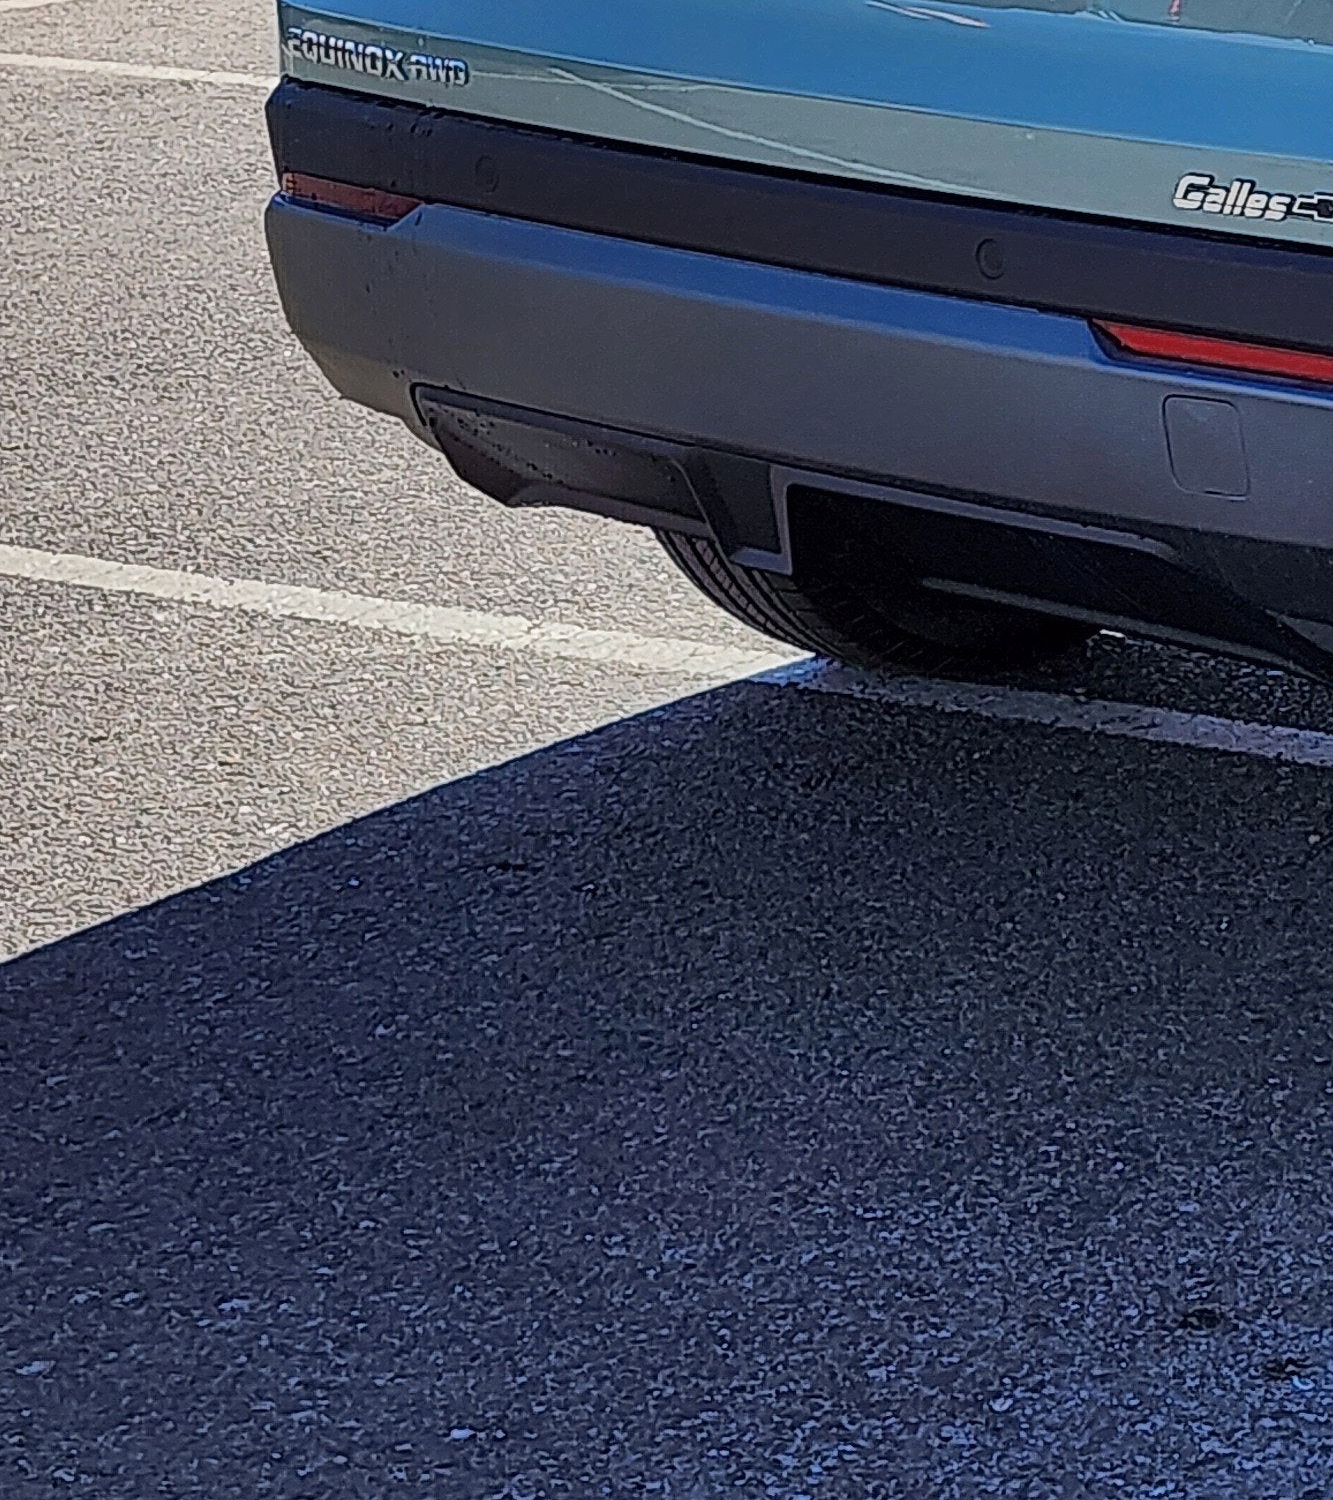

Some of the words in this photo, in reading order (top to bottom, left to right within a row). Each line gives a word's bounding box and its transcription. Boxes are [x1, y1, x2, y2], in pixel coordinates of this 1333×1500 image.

[286, 27, 406, 82] EQUINOX
[408, 55, 469, 86] AWD
[1172, 173, 1292, 221] Galles
